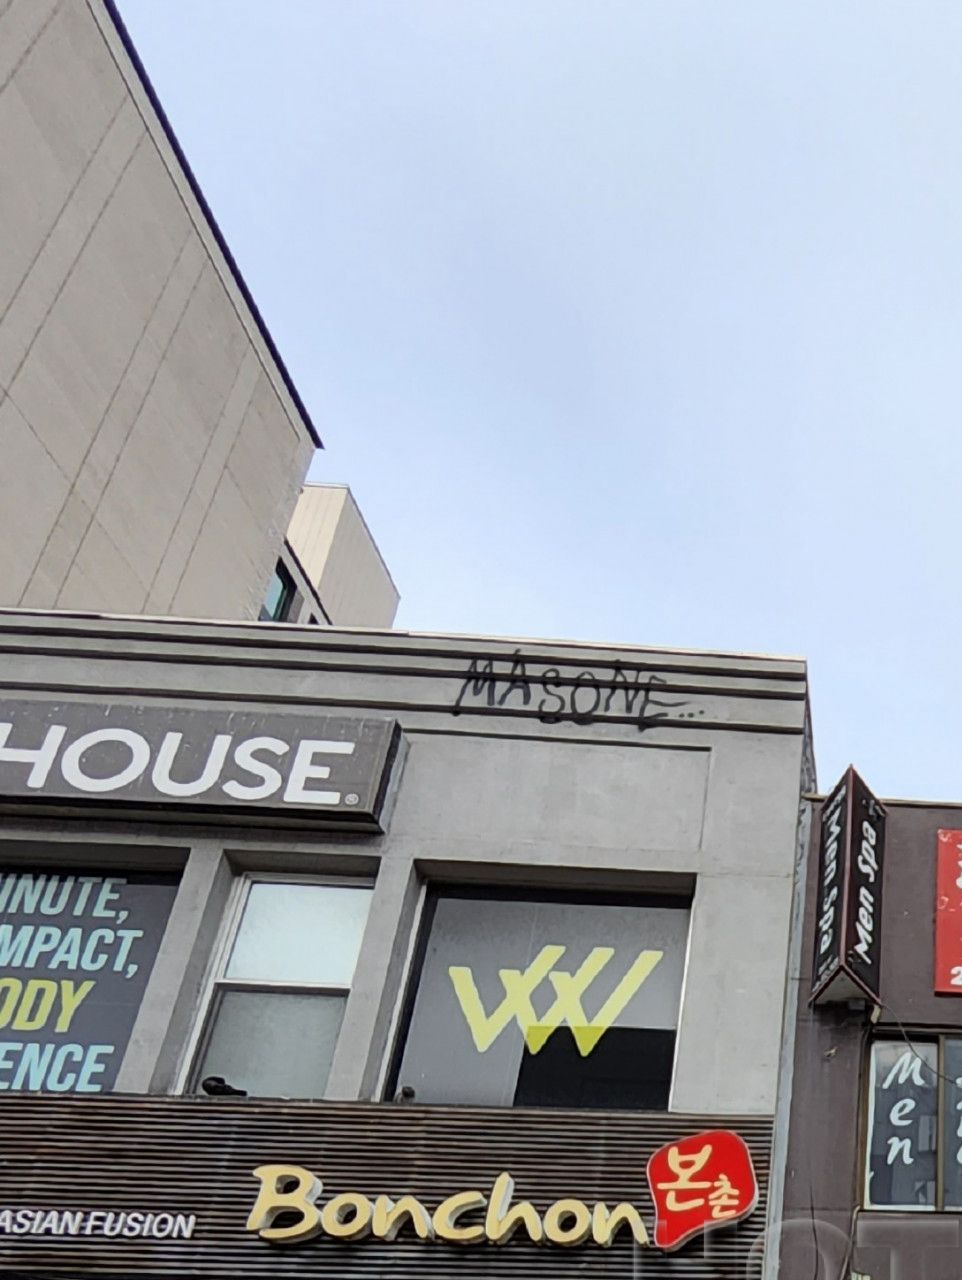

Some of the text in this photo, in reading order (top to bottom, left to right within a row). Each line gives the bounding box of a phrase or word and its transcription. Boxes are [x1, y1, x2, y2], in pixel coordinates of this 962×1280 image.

[857, 820, 879, 883] Spa
[0, 923, 144, 979] MPACT,
[853, 885, 875, 965] Men
[0, 977, 96, 1033] ODY
[0, 1042, 115, 1093] ENCE
[0, 1209, 197, 1239] ASIAN FUSION
[246, 1165, 651, 1245] Bonchon
